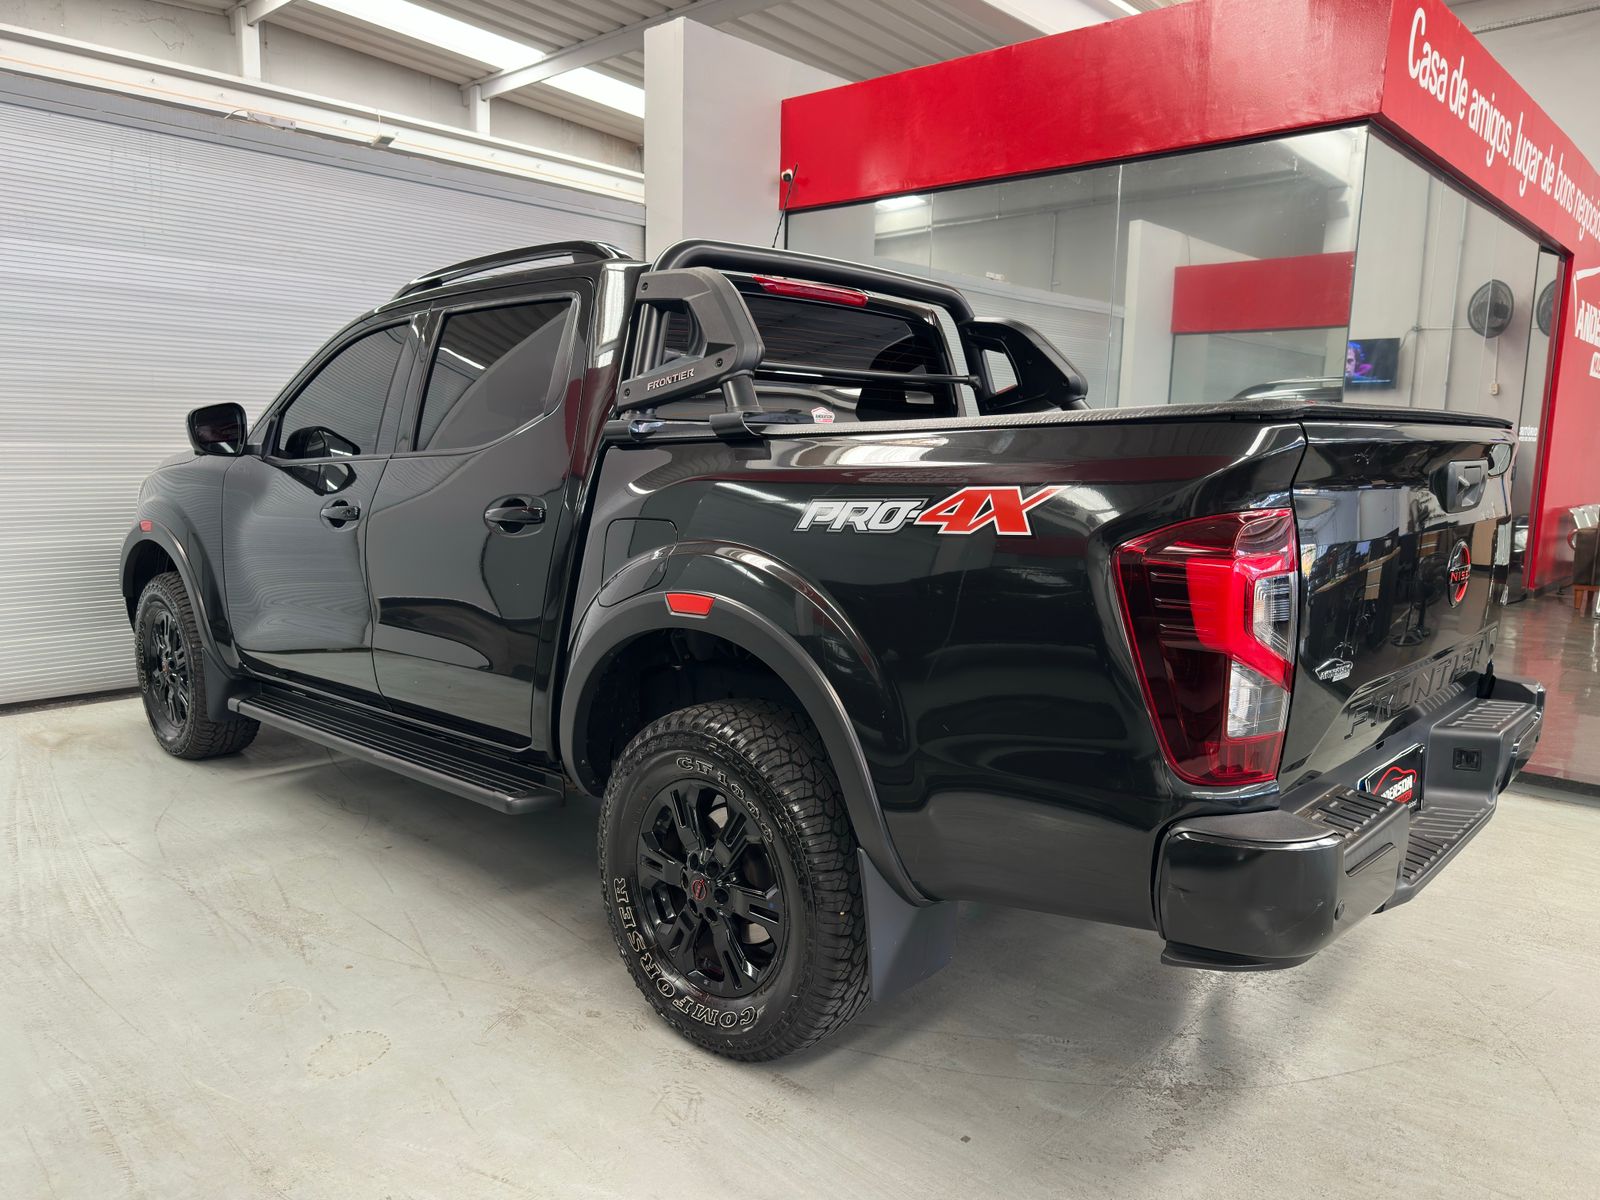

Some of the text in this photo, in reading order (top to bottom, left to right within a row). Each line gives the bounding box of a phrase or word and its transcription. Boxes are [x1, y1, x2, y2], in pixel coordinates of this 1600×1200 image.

[1407, 7, 1448, 104] Casa
[1449, 56, 1468, 121] de
[1468, 89, 1512, 167] amigos,
[1512, 112, 1543, 198] lugar
[1541, 144, 1555, 195] de
[1554, 152, 1576, 213] bons
[647, 367, 695, 391] FRONTIER
[613, 877, 758, 1028] COMFORSER
